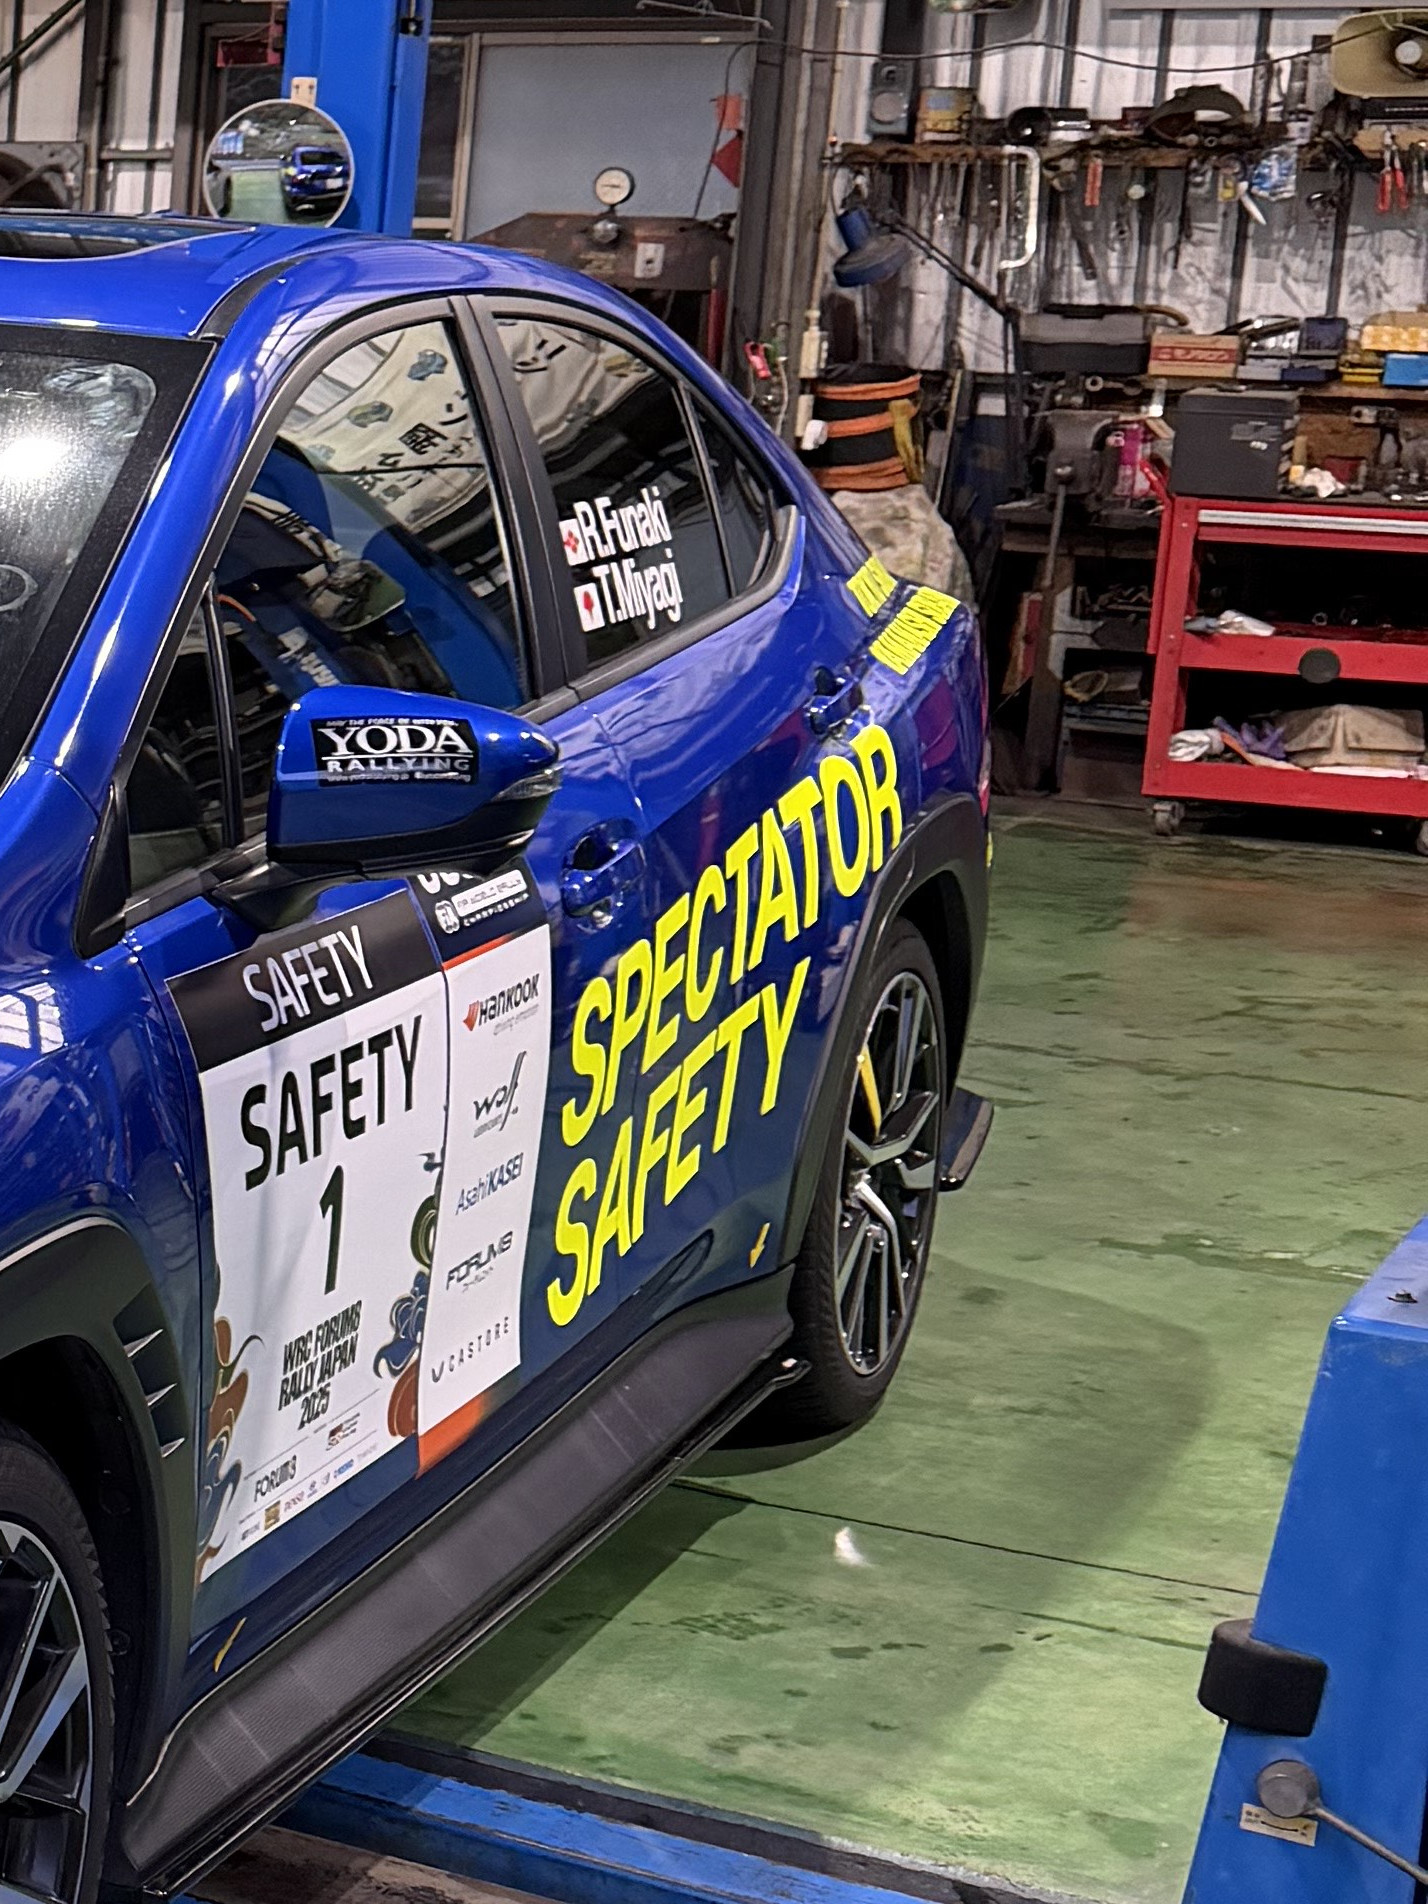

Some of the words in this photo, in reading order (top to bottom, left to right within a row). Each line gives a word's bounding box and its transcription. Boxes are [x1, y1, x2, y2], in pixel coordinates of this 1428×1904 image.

[573, 486, 673, 560] R.Funaki
[592, 548, 684, 630] T.Miyagi
[318, 724, 474, 756] YODA
[326, 757, 470, 773] RALLYING
[562, 724, 904, 1147] SPECTATOR
[242, 923, 375, 1032] SAFETY
[241, 1014, 424, 1193] SAFETY
[548, 956, 812, 1327] SAFETY
[319, 1164, 345, 1296] 1
[278, 1356, 318, 1411] RALLY
[316, 1332, 359, 1388] JAPAN
[283, 1329, 314, 1376] WRC
[313, 1299, 363, 1359] FORUM8
[448, 1316, 510, 1372] CASTORE
[297, 1382, 332, 1431] 2025
